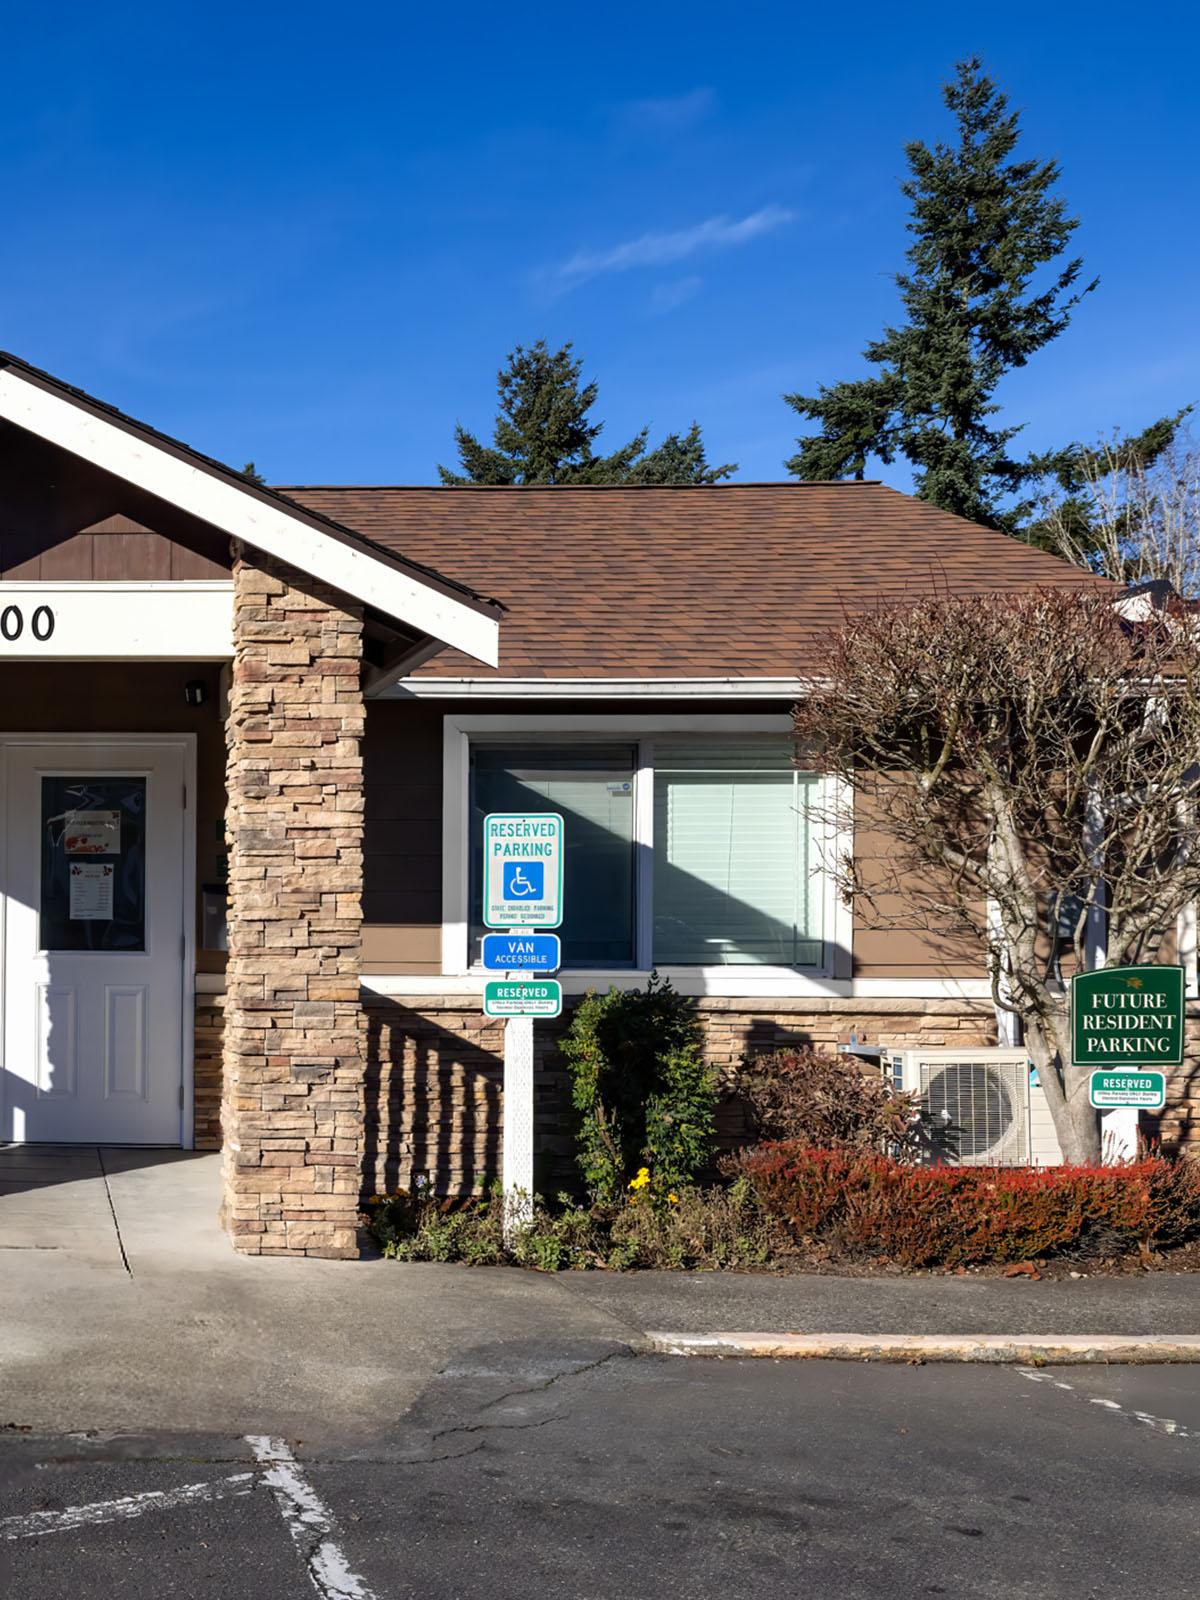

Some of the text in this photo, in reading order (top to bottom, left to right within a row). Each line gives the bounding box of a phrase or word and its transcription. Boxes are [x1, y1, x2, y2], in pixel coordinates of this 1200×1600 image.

[490, 823, 556, 837] RESERVED
[494, 842, 552, 856] PARKING
[508, 942, 534, 953] VAN
[495, 955, 548, 963] ACCESSIBLE
[497, 987, 548, 997] RESERVED
[1091, 993, 1168, 1009] FUTURE
[1082, 1014, 1176, 1030] RESIDENT
[1087, 1037, 1170, 1053] PARKING
[1103, 1078, 1152, 1088] RESERVED
